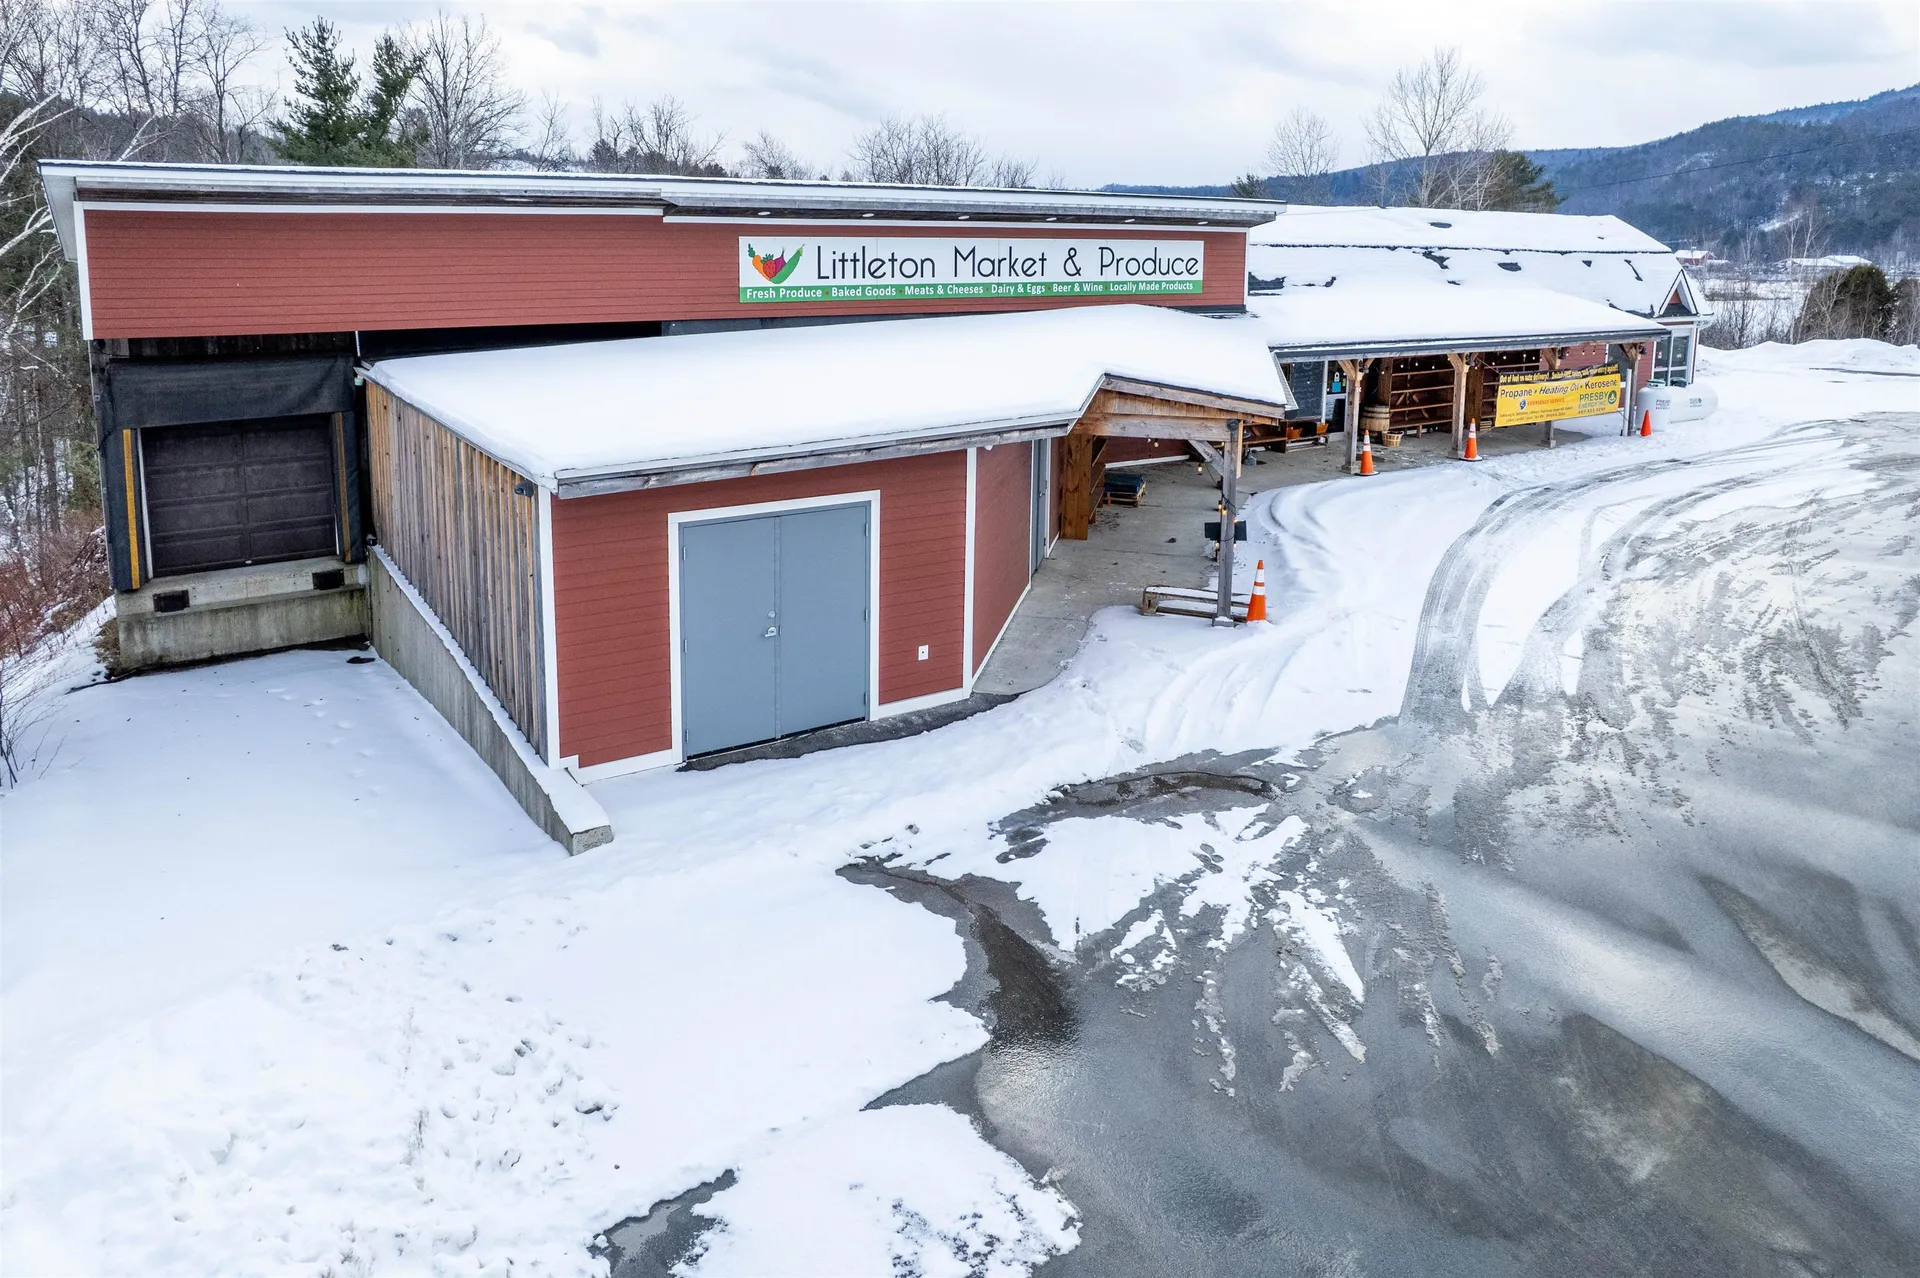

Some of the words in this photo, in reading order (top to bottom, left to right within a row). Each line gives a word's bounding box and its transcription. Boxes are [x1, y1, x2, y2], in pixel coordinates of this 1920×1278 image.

[817, 245, 936, 280] Littleton
[954, 245, 1047, 278] Market
[1063, 246, 1082, 277] &
[1099, 246, 1199, 277] Produce
[746, 288, 776, 299] Fresh
[779, 288, 822, 298] Produce
[831, 287, 864, 297] Baked
[865, 286, 896, 297] Goods
[905, 285, 934, 296] Meats
[937, 285, 945, 295] &
[947, 284, 984, 295] Cheeses
[991, 283, 1015, 296] Dairy
[1017, 283, 1025, 293] &
[1026, 283, 1046, 295] Eggs
[1053, 283, 1072, 293] Beer
[1073, 283, 1081, 292] &
[1082, 282, 1103, 292] Wine
[1110, 282, 1137, 293] Locally
[1138, 281, 1160, 291] Made
[1161, 281, 1193, 291] Products
[1500, 389, 1532, 399] Propane
[1538, 385, 1569, 395] Heating
[1570, 383, 1579, 392] Oil
[1585, 380, 1617, 389] Kerosene
[1579, 391, 1609, 402] PRESBY
